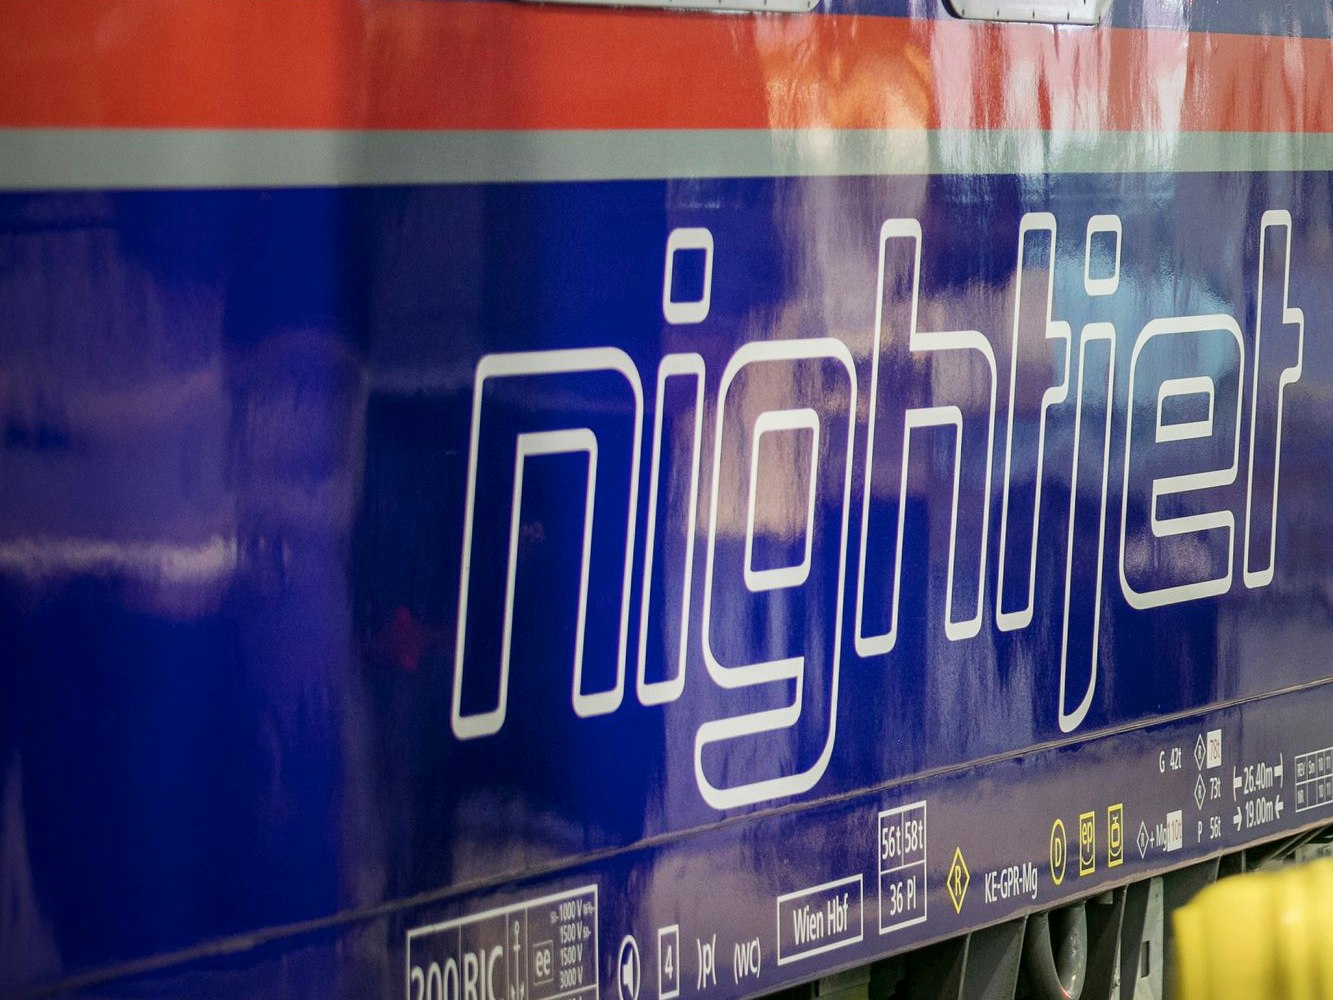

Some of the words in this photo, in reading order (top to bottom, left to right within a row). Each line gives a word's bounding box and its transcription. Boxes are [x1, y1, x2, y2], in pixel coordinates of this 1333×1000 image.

[451, 209, 1305, 810] nightjet
[1159, 750, 1165, 773] G
[1170, 747, 1182, 771] 42t
[1209, 777, 1221, 800] 73t
[1243, 762, 1274, 795] 26.40m
[1245, 796, 1274, 829] 19.00m
[881, 825, 901, 860] 56t
[904, 819, 924, 854] 58t
[1082, 821, 1093, 853] ep
[1198, 821, 1203, 843] P
[1209, 815, 1221, 840] 56t
[1054, 837, 1062, 868] D
[954, 865, 962, 896] R
[984, 861, 1039, 904] KE-GPR-Mg
[559, 900, 576, 921] 1000
[890, 881, 903, 916] 36
[560, 922, 576, 944] 1500
[793, 904, 824, 946] Wien
[827, 892, 849, 937] Hbf
[535, 947, 551, 977] ee
[560, 945, 577, 967] 1500
[664, 945, 674, 980] 4
[464, 945, 504, 1000] RIC
[559, 967, 577, 989] 3000
